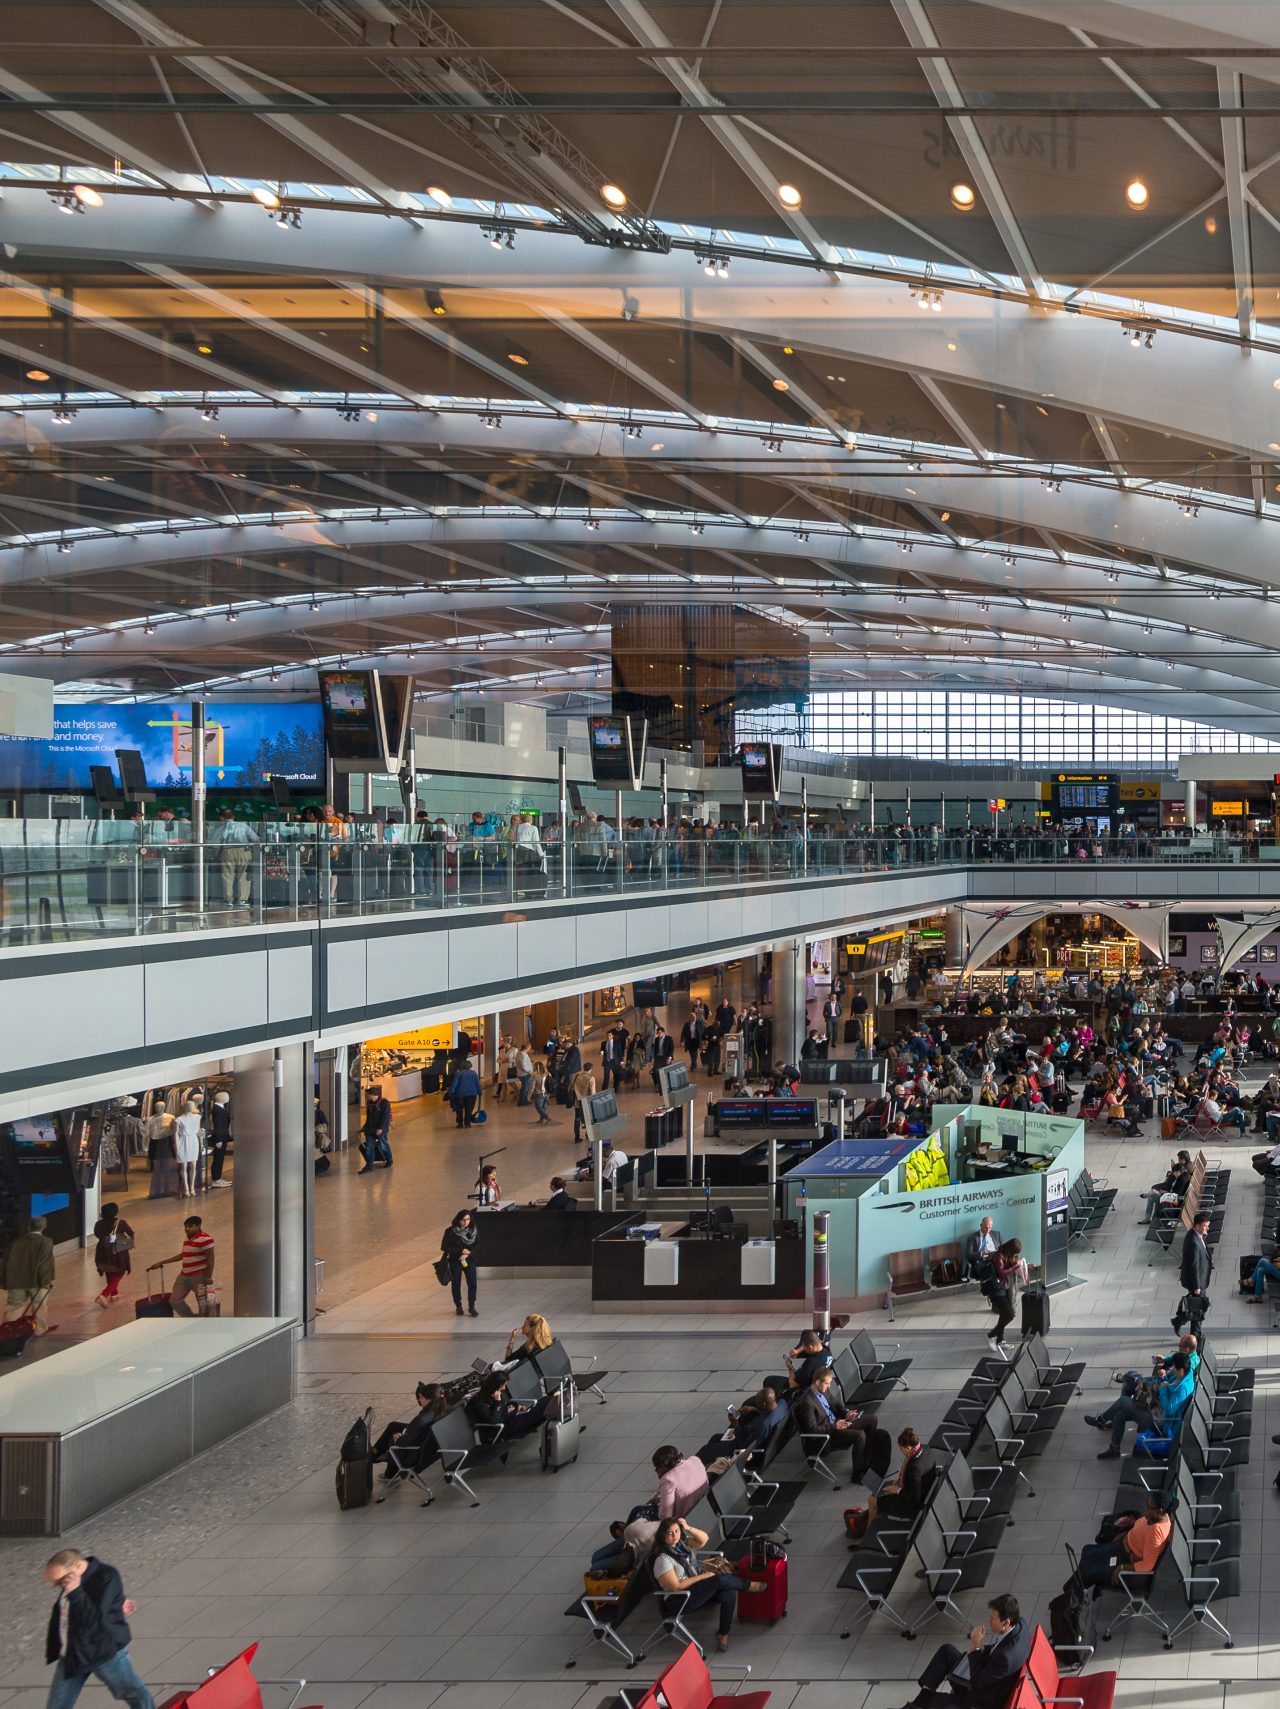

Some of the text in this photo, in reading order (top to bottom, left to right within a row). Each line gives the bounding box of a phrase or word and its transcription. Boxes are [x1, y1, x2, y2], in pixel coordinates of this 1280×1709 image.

[54, 720, 117, 731] that helps save
[54, 732, 71, 740] and
[74, 733, 105, 743] money.
[1056, 951, 1072, 961] PRET
[919, 1189, 1004, 1208] BRITISH AIRWAYS
[919, 1207, 962, 1220] Customer
[963, 1202, 999, 1214] Services
[1006, 1195, 1036, 1207] Central
